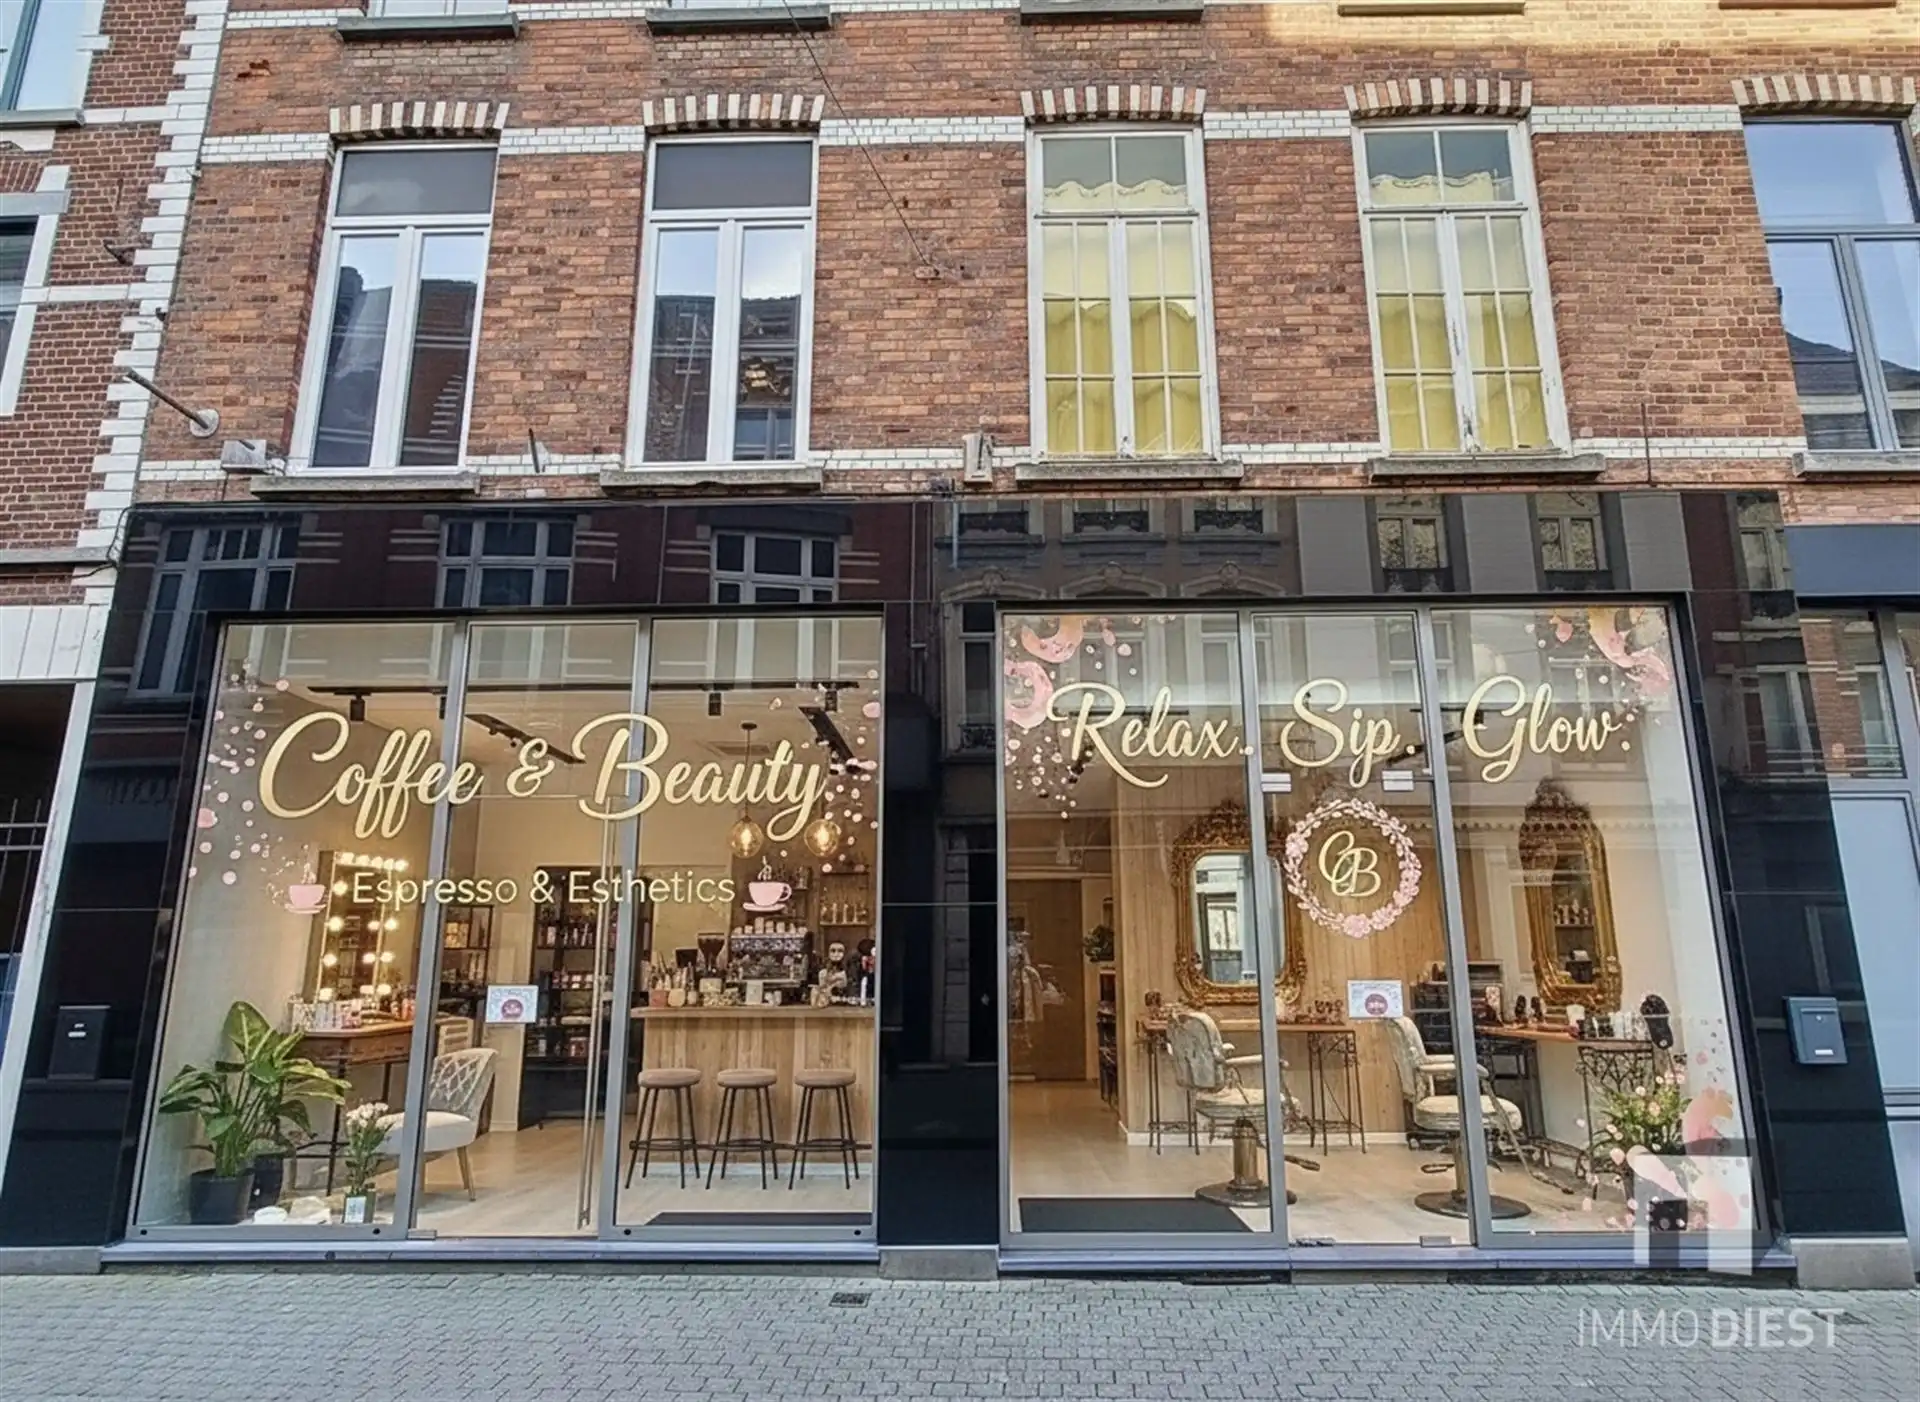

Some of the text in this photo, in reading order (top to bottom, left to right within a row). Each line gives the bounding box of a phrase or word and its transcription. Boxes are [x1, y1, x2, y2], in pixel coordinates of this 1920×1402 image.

[259, 711, 827, 842] Coffee & Beauty
[352, 869, 736, 911] Espresso & Esthetics
